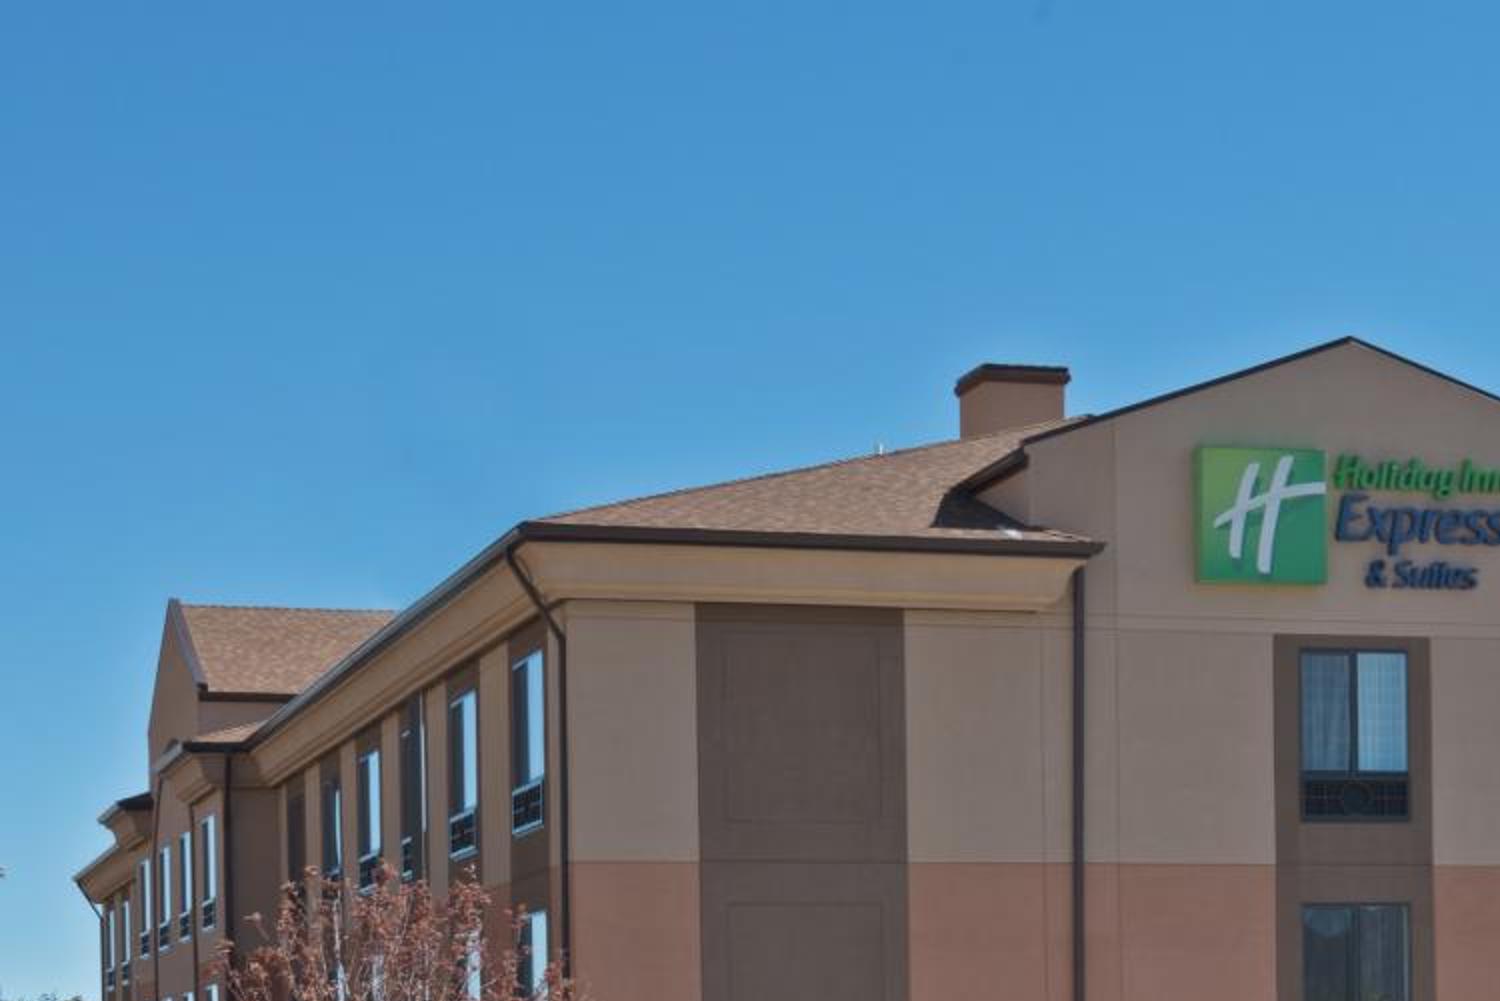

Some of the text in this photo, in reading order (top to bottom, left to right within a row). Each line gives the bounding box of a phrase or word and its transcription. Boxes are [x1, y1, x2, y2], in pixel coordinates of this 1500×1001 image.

[1334, 455, 1454, 498] Holiday
[1364, 559, 1479, 590] & Suites
